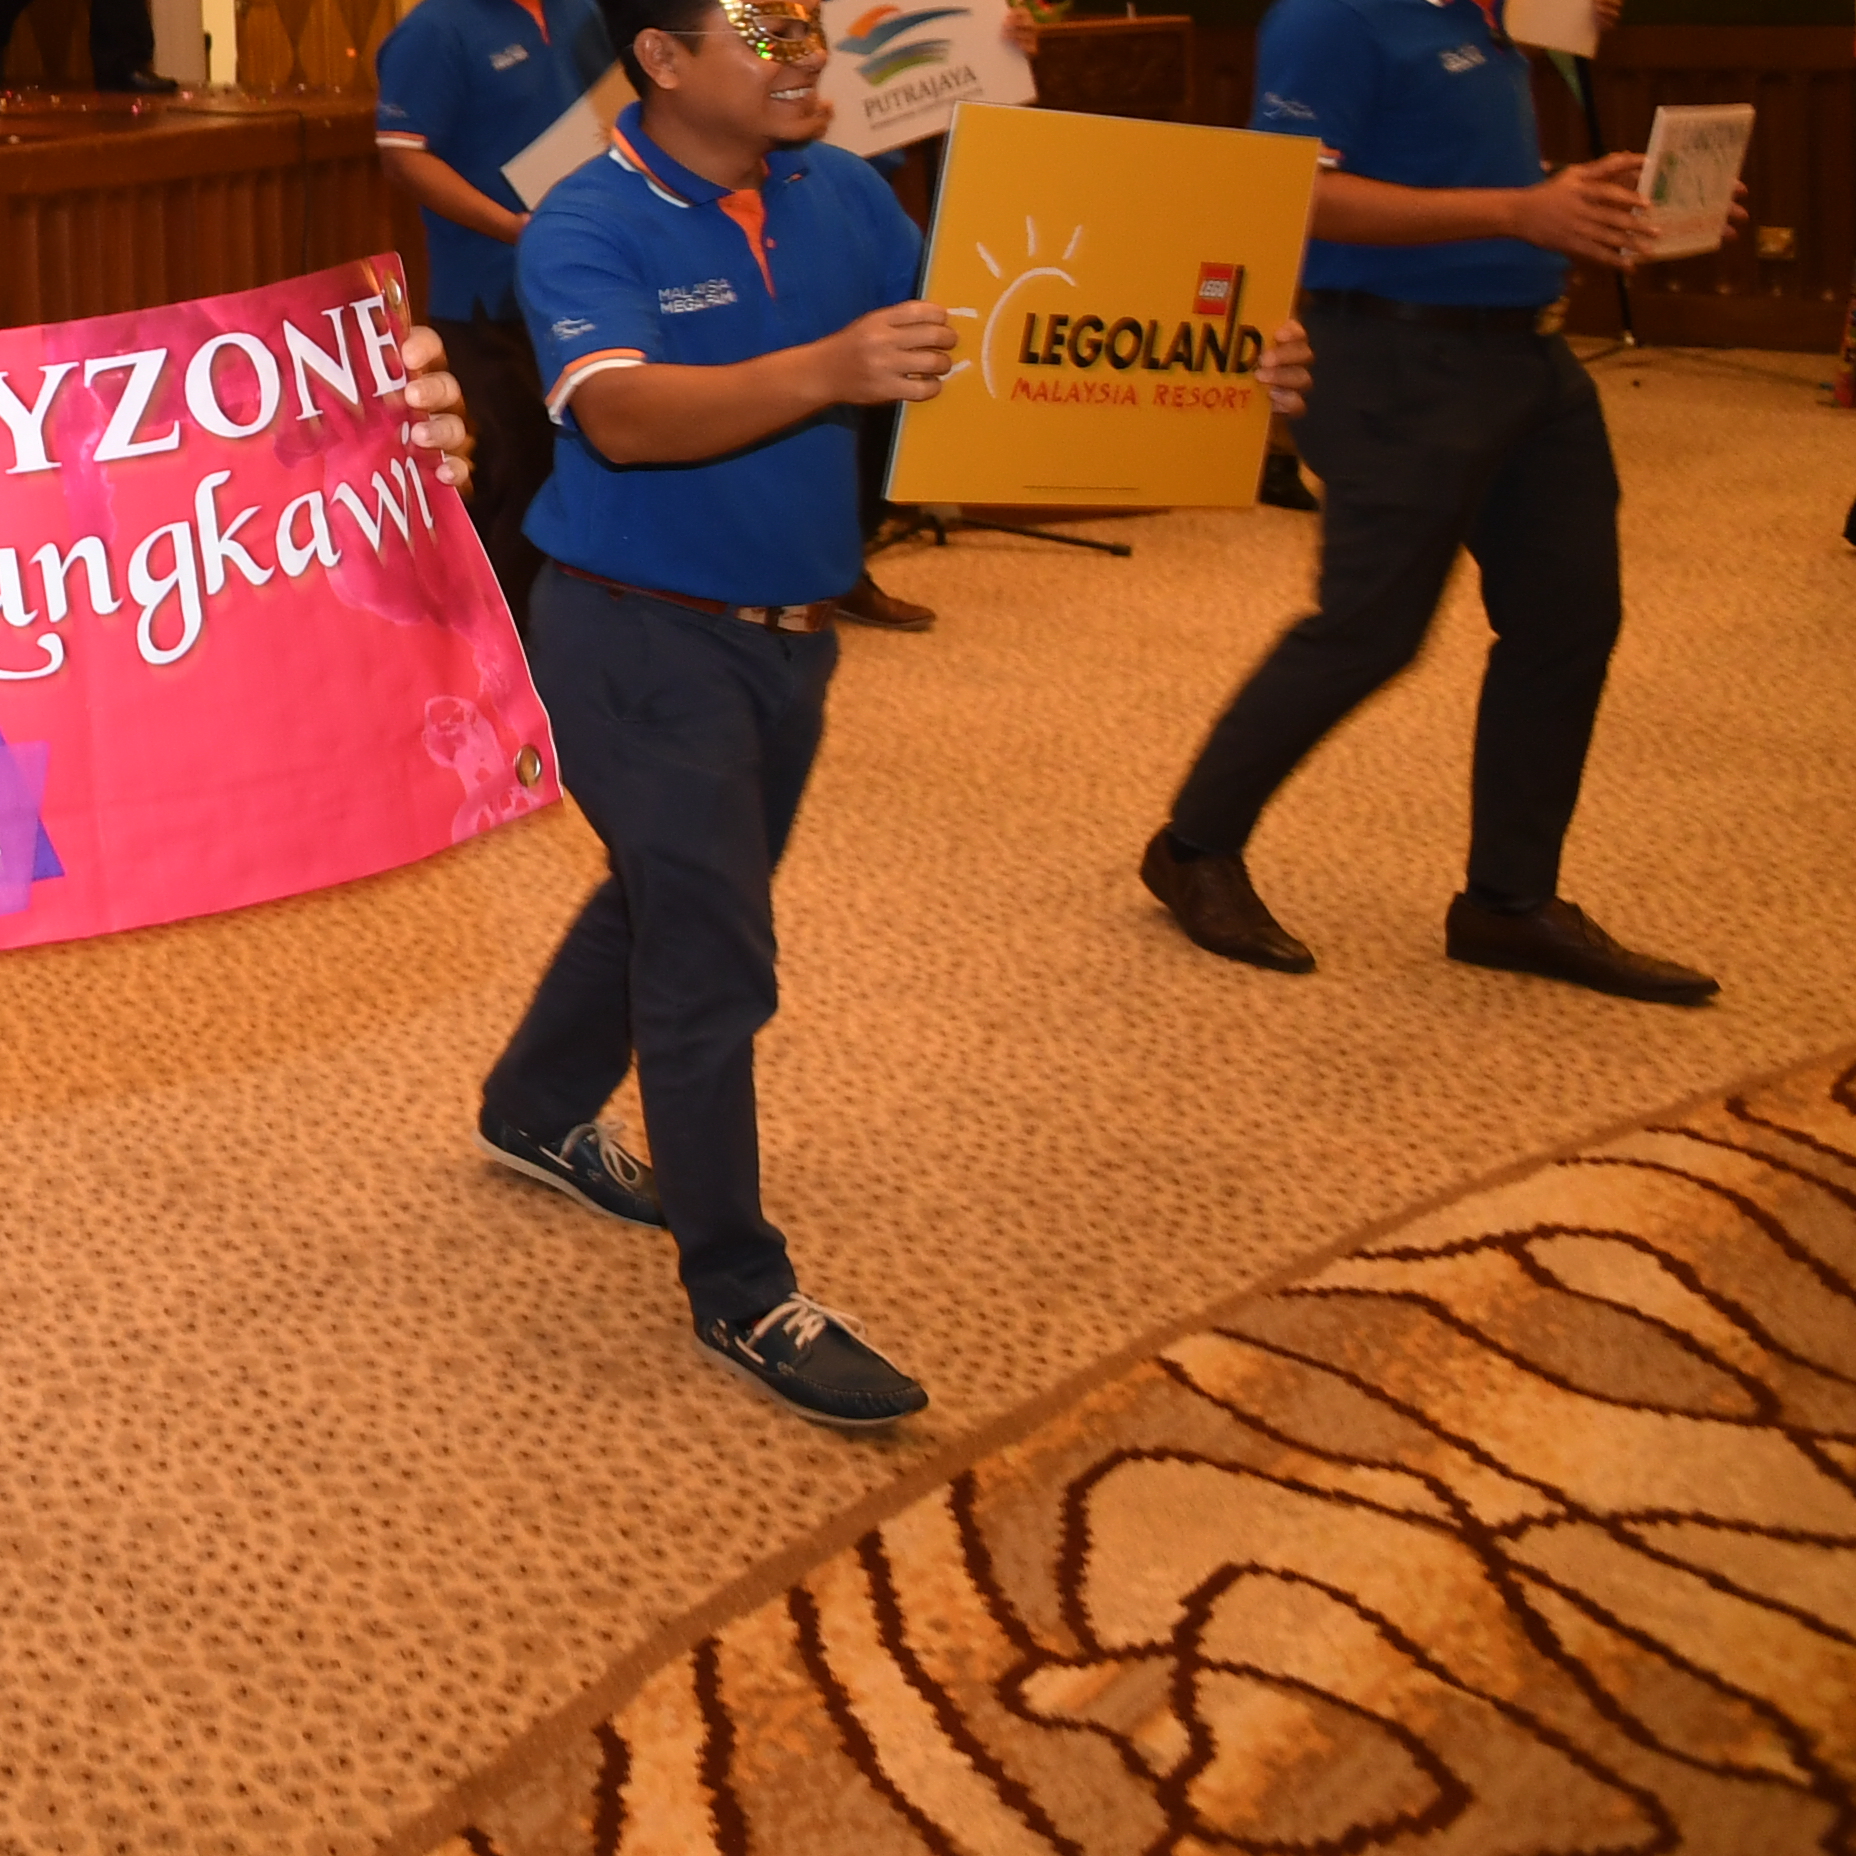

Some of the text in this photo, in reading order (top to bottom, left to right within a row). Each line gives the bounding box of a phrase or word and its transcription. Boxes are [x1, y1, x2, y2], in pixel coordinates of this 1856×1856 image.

[863, 64, 977, 118] PUTRAJAYA
[1197, 278, 1231, 300] LEGO
[1018, 265, 1264, 374] LEGOLAND
[1010, 376, 1253, 409] MALAYSIA RESORT
